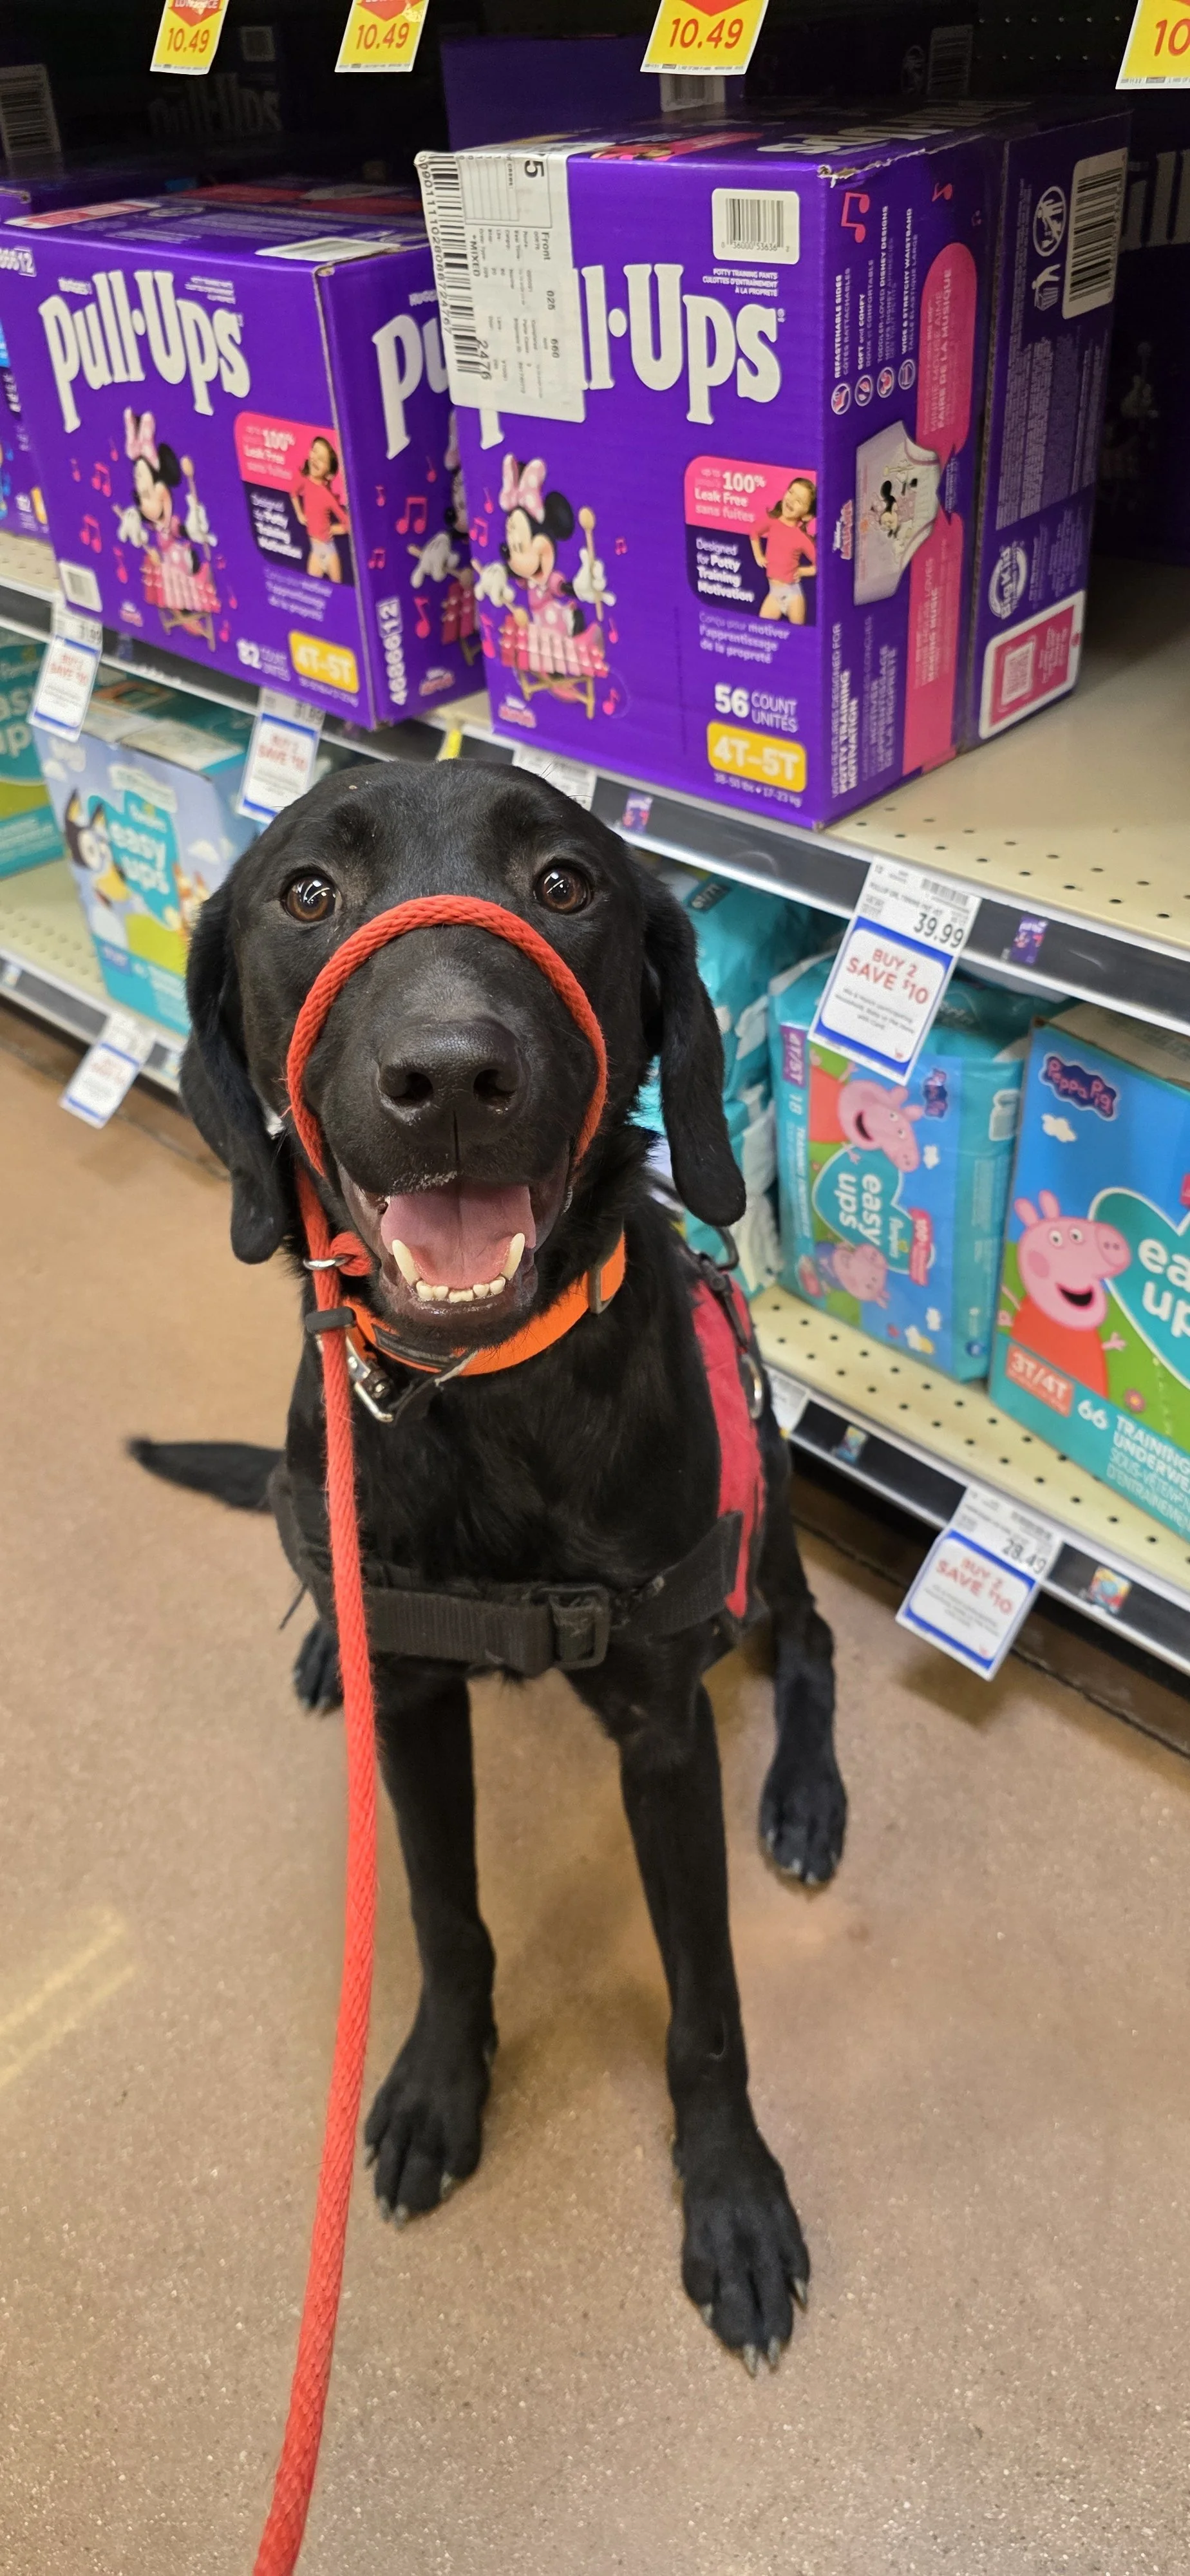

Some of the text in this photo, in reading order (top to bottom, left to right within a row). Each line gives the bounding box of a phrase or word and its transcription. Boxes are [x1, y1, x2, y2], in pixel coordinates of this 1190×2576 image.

[167, 27, 210, 53] 10.49
[356, 23, 410, 50] 10.49
[669, 17, 744, 49] 10.49
[524, 160, 545, 178] 5
[542, 232, 551, 260] Front
[732, 240, 754, 251] 36000
[759, 271, 778, 280] PANTS
[941, 269, 952, 337] MUSIQUE
[722, 471, 766, 493] 100%
[695, 487, 748, 507] Leak Free
[696, 537, 738, 556] Designed
[710, 553, 741, 573] Potty
[696, 565, 742, 588] Training
[697, 580, 755, 603] Motivation
[714, 683, 749, 719] 56
[751, 690, 797, 716] COUNT
[914, 912, 965, 949] 39.99
[873, 949, 918, 979] BUY 2
[847, 956, 929, 1005] SAVE $10
[834, 1172, 857, 1229] ups
[861, 1173, 882, 1246] easy
[1077, 1399, 1109, 1430] 66
[936, 1558, 984, 1598] SAVE
[962, 1557, 990, 1578] BUY
